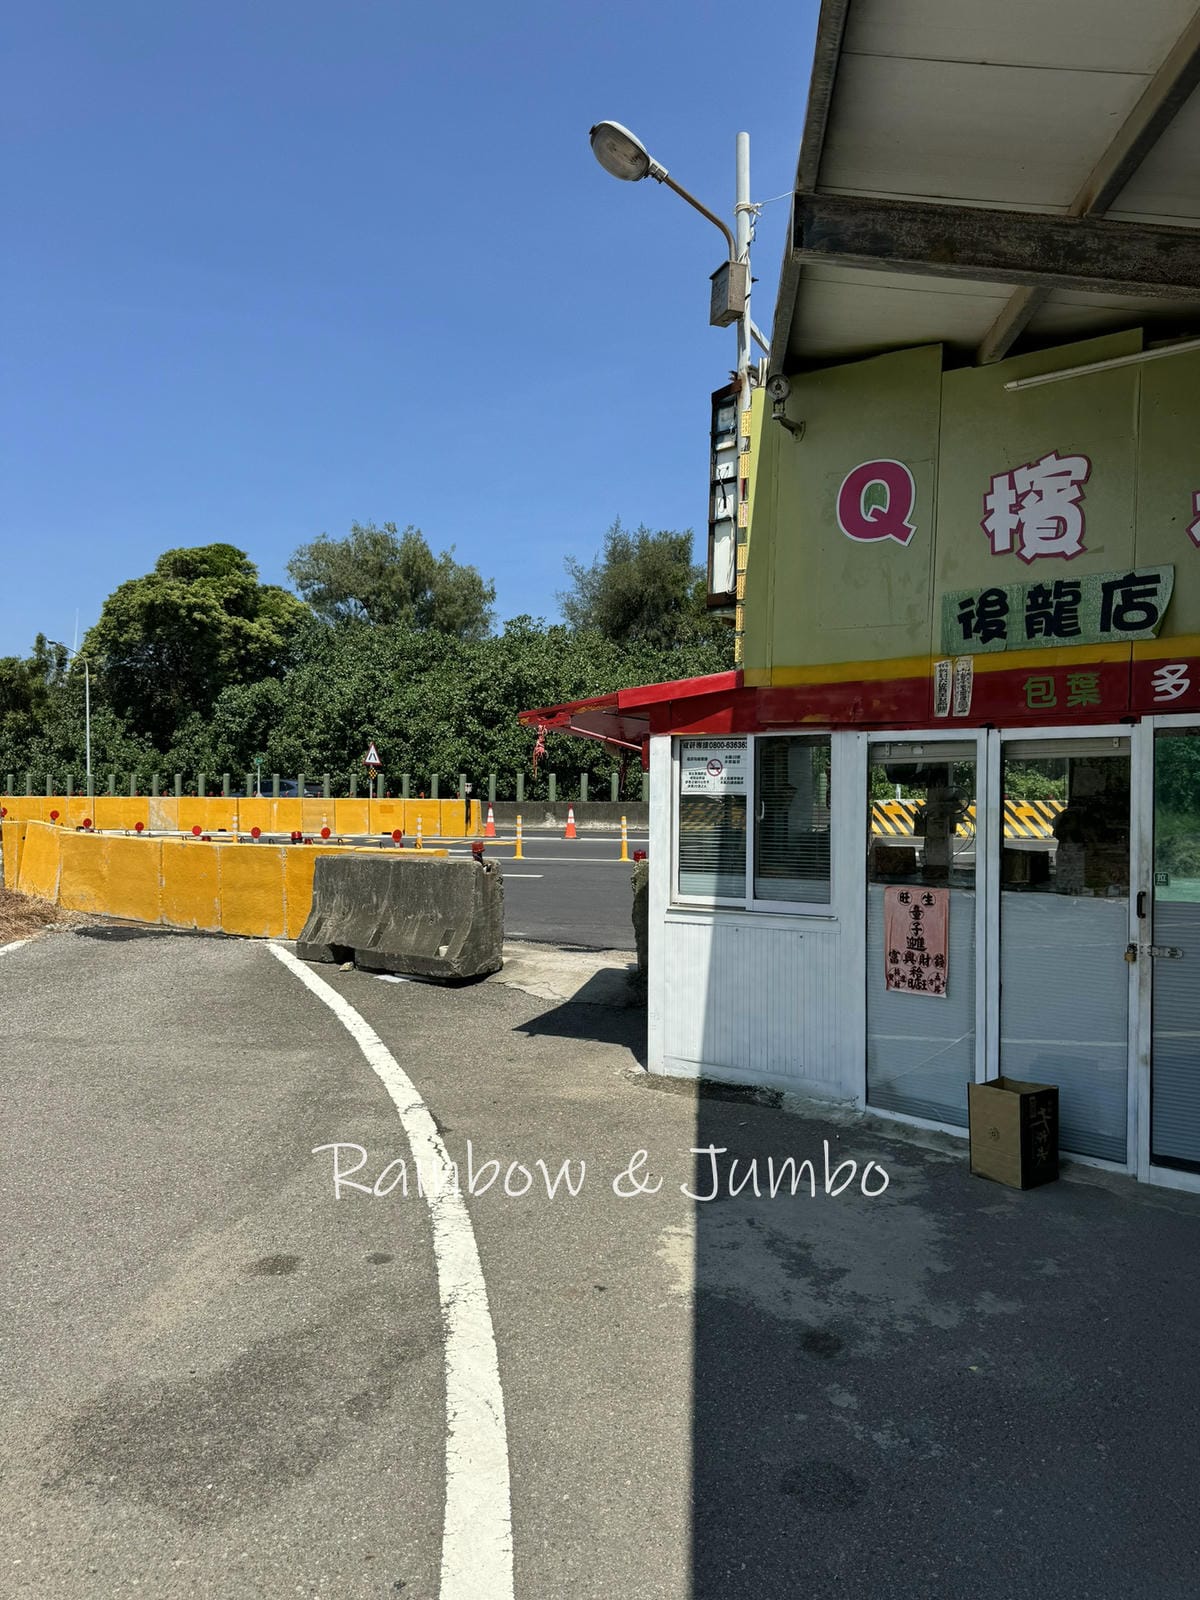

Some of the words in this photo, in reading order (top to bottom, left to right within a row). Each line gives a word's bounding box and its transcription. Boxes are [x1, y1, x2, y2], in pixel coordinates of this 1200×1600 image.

[957, 572, 1161, 645] 後龍店
[1023, 672, 1102, 709] 包葉
